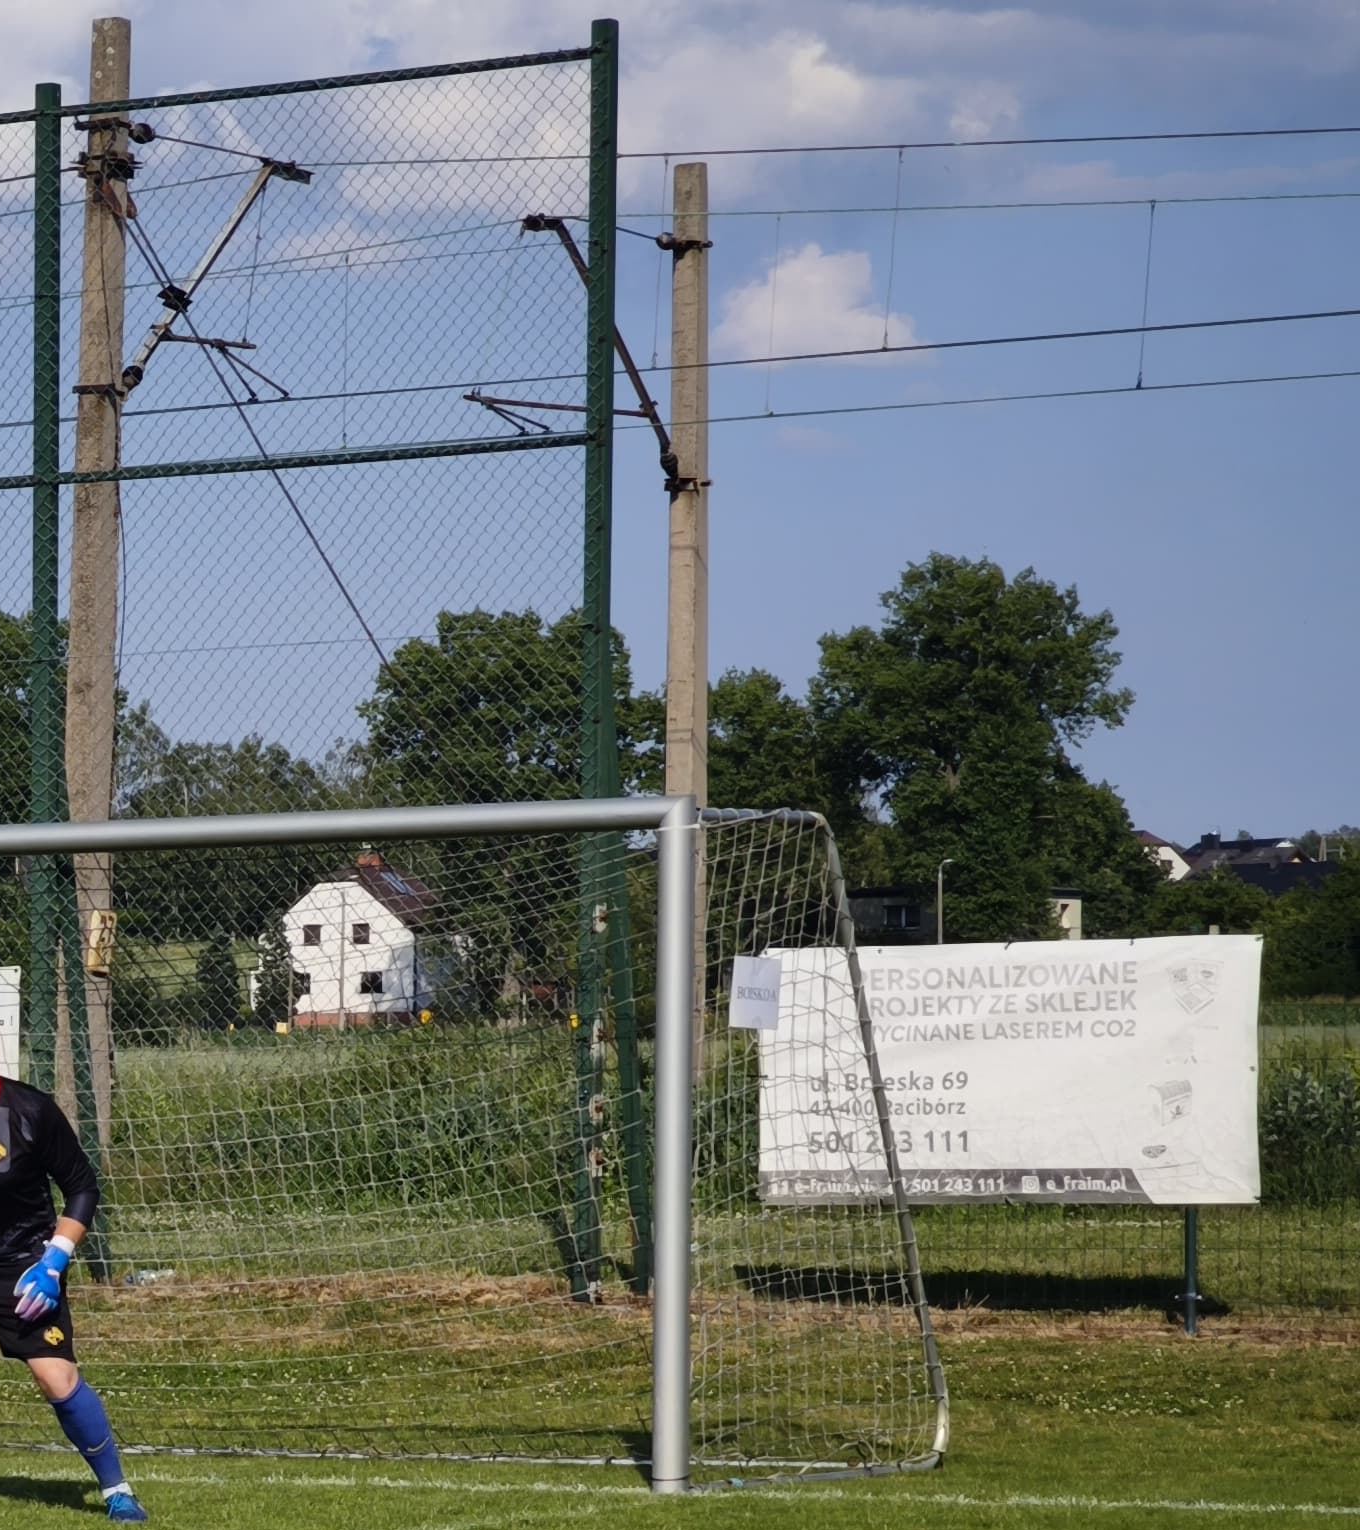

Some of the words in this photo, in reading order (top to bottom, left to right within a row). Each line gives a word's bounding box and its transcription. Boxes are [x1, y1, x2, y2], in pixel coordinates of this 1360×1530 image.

[861, 960, 1138, 992] ERSONALIZOWANE
[870, 995, 985, 1017] ROJEKTY
[988, 994, 1018, 1014] ZE
[1025, 990, 1137, 1013] SKLEJEK
[982, 1020, 1083, 1040] LASEREM
[1091, 1019, 1137, 1038] CO2
[845, 1071, 934, 1091] Breska
[942, 1071, 969, 1090] 69
[808, 1131, 854, 1154] 501
[866, 1131, 913, 1154] 23
[924, 1130, 969, 1153] 111
[912, 1178, 938, 1192] 501
[945, 1178, 973, 1192] 243
[978, 1176, 1004, 1191] 111
